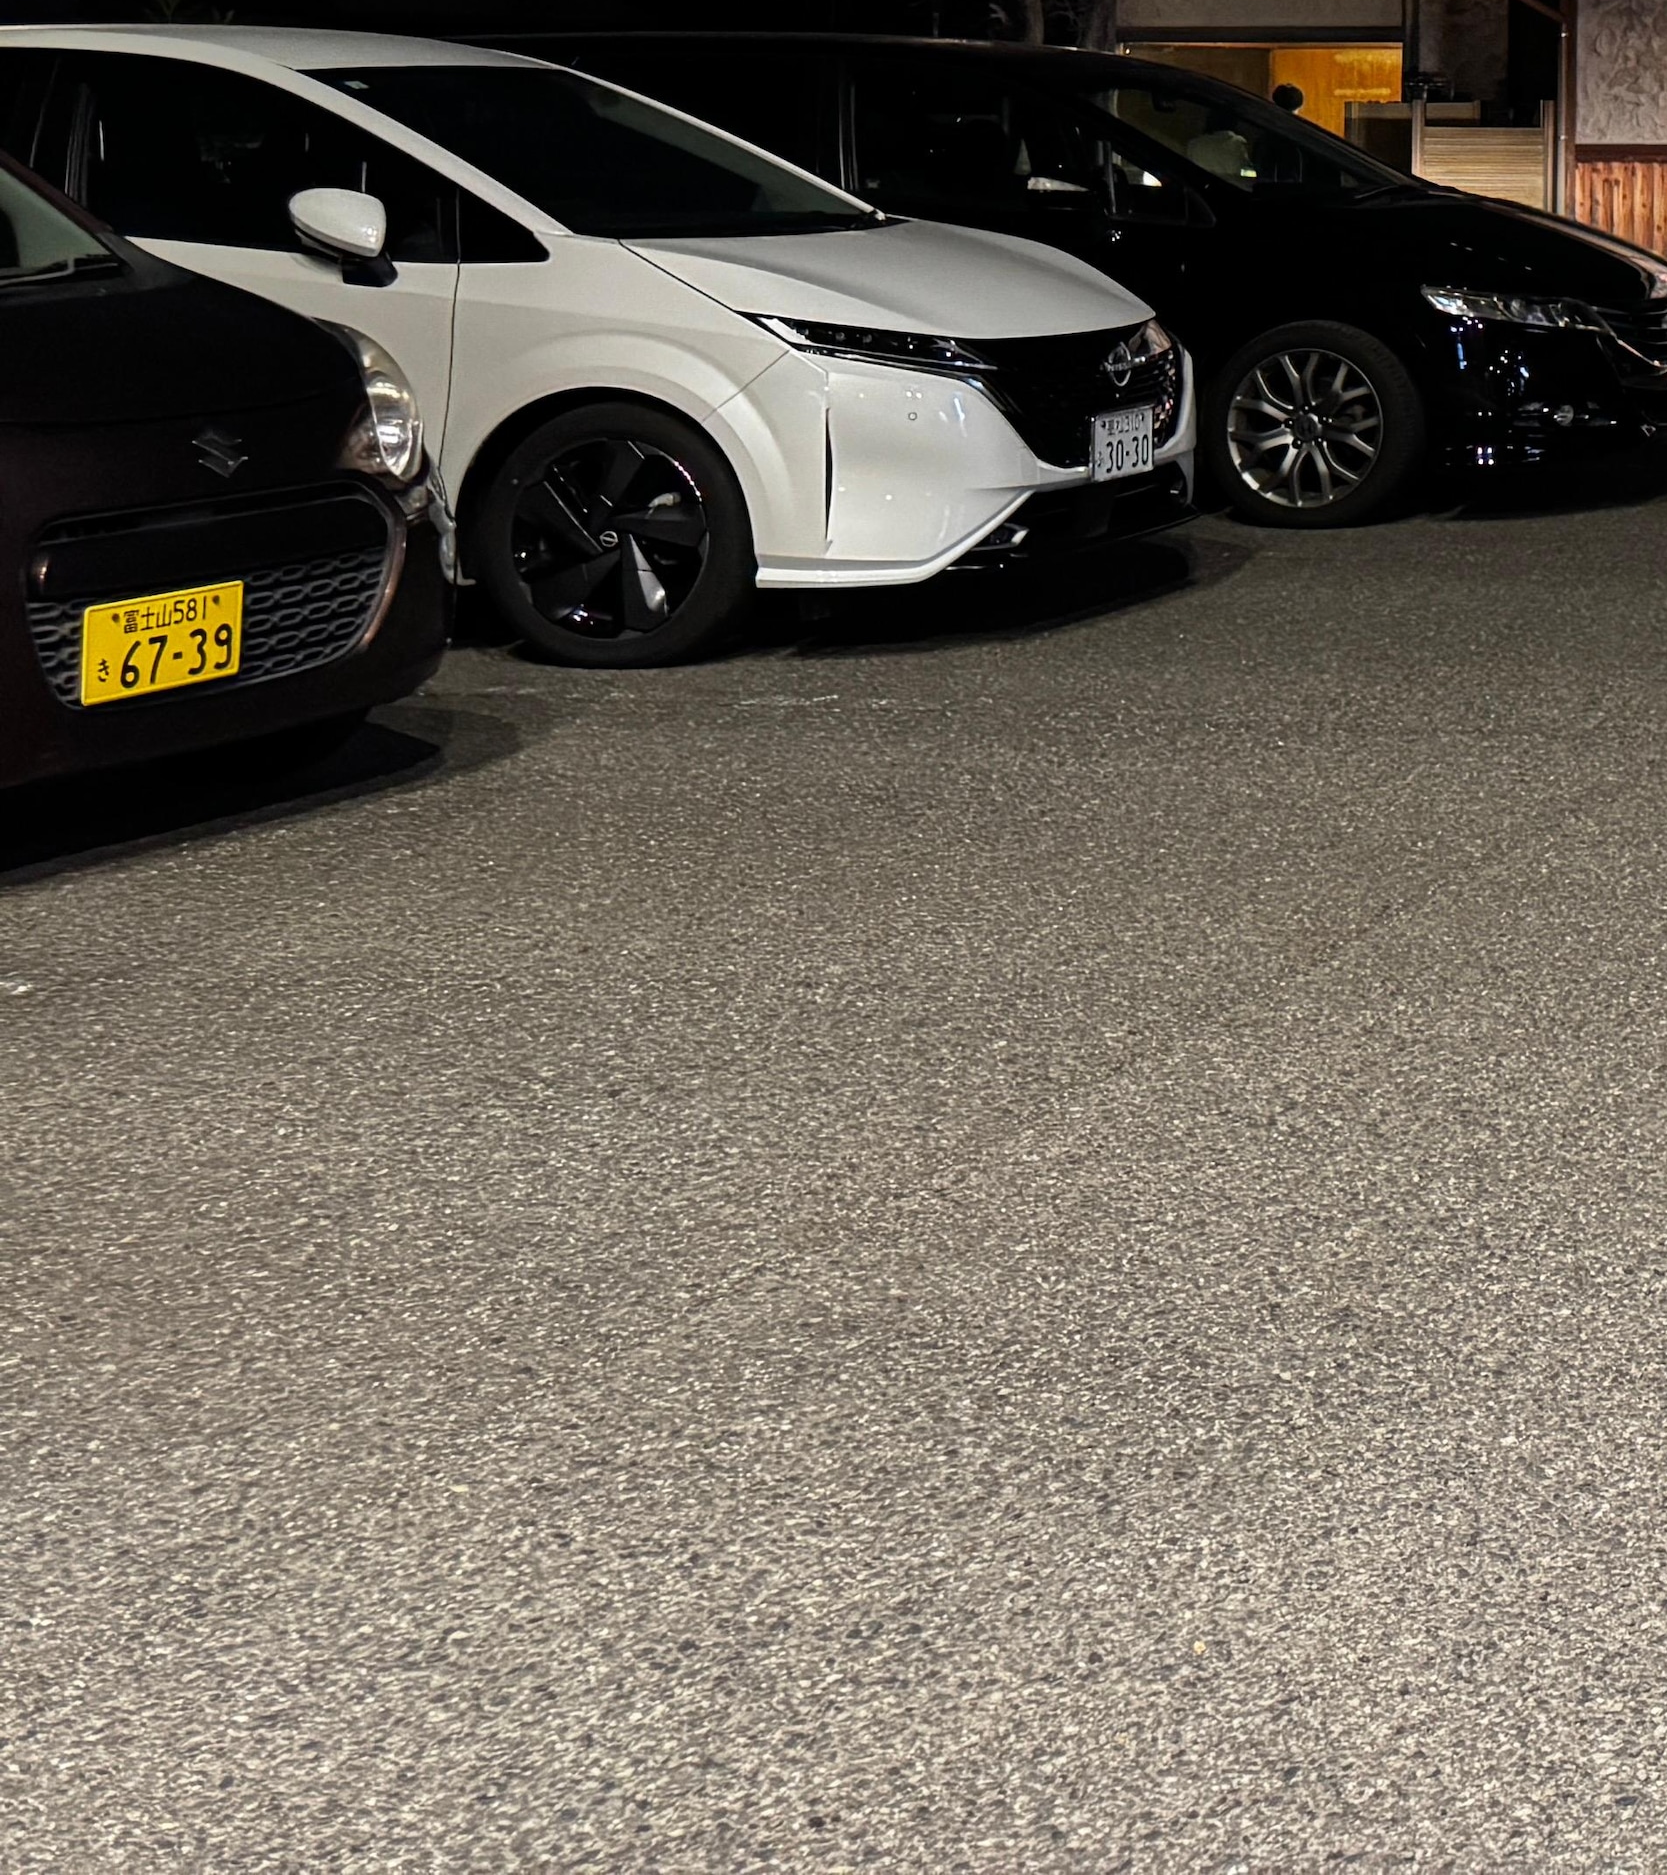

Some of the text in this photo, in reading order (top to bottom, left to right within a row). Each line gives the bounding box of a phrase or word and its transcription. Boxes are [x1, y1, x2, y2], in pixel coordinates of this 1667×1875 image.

[1106, 433, 1149, 474] 30-30
[97, 623, 233, 689] き 67-39
